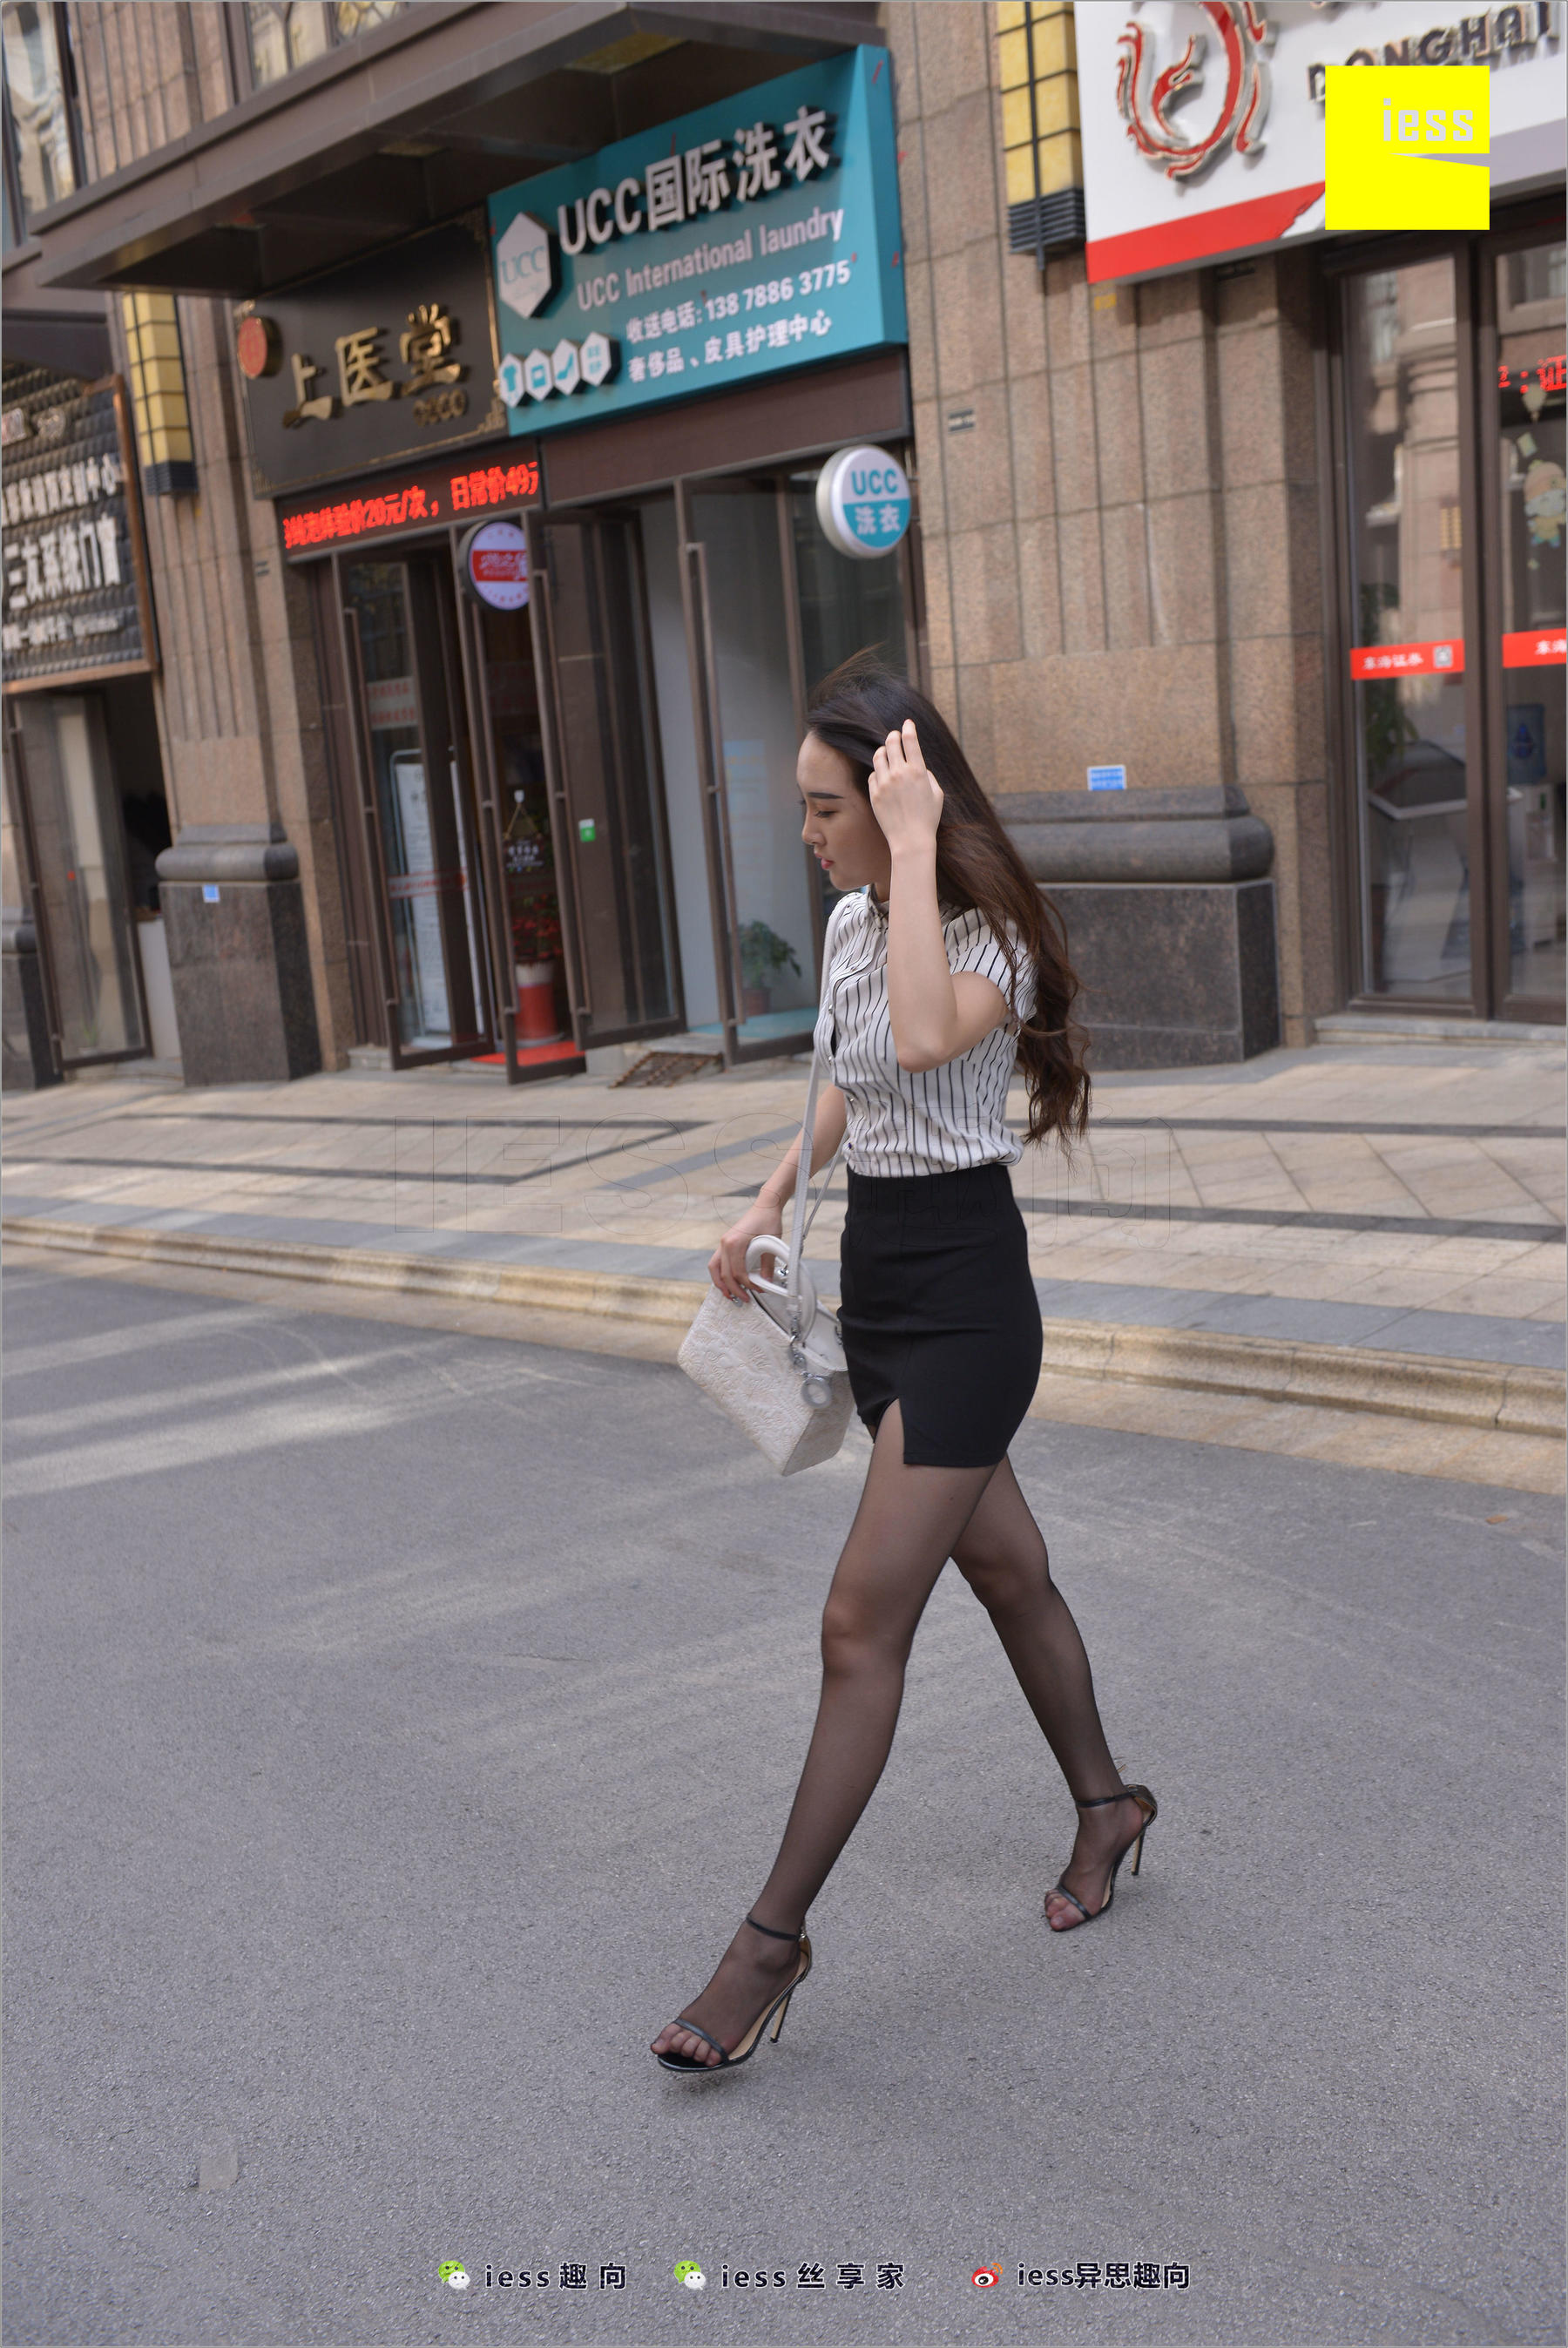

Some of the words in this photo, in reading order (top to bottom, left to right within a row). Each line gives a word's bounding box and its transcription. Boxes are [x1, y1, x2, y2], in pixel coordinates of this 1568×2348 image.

[558, 105, 830, 256] UCC国际洗衣
[501, 245, 546, 285] UCC
[577, 271, 621, 312] UCC
[626, 228, 753, 297] International
[760, 206, 844, 256] laundry
[742, 277, 794, 311] 7886
[799, 260, 851, 296] 3775
[282, 303, 462, 429] 上医堂
[851, 467, 899, 497] UCC
